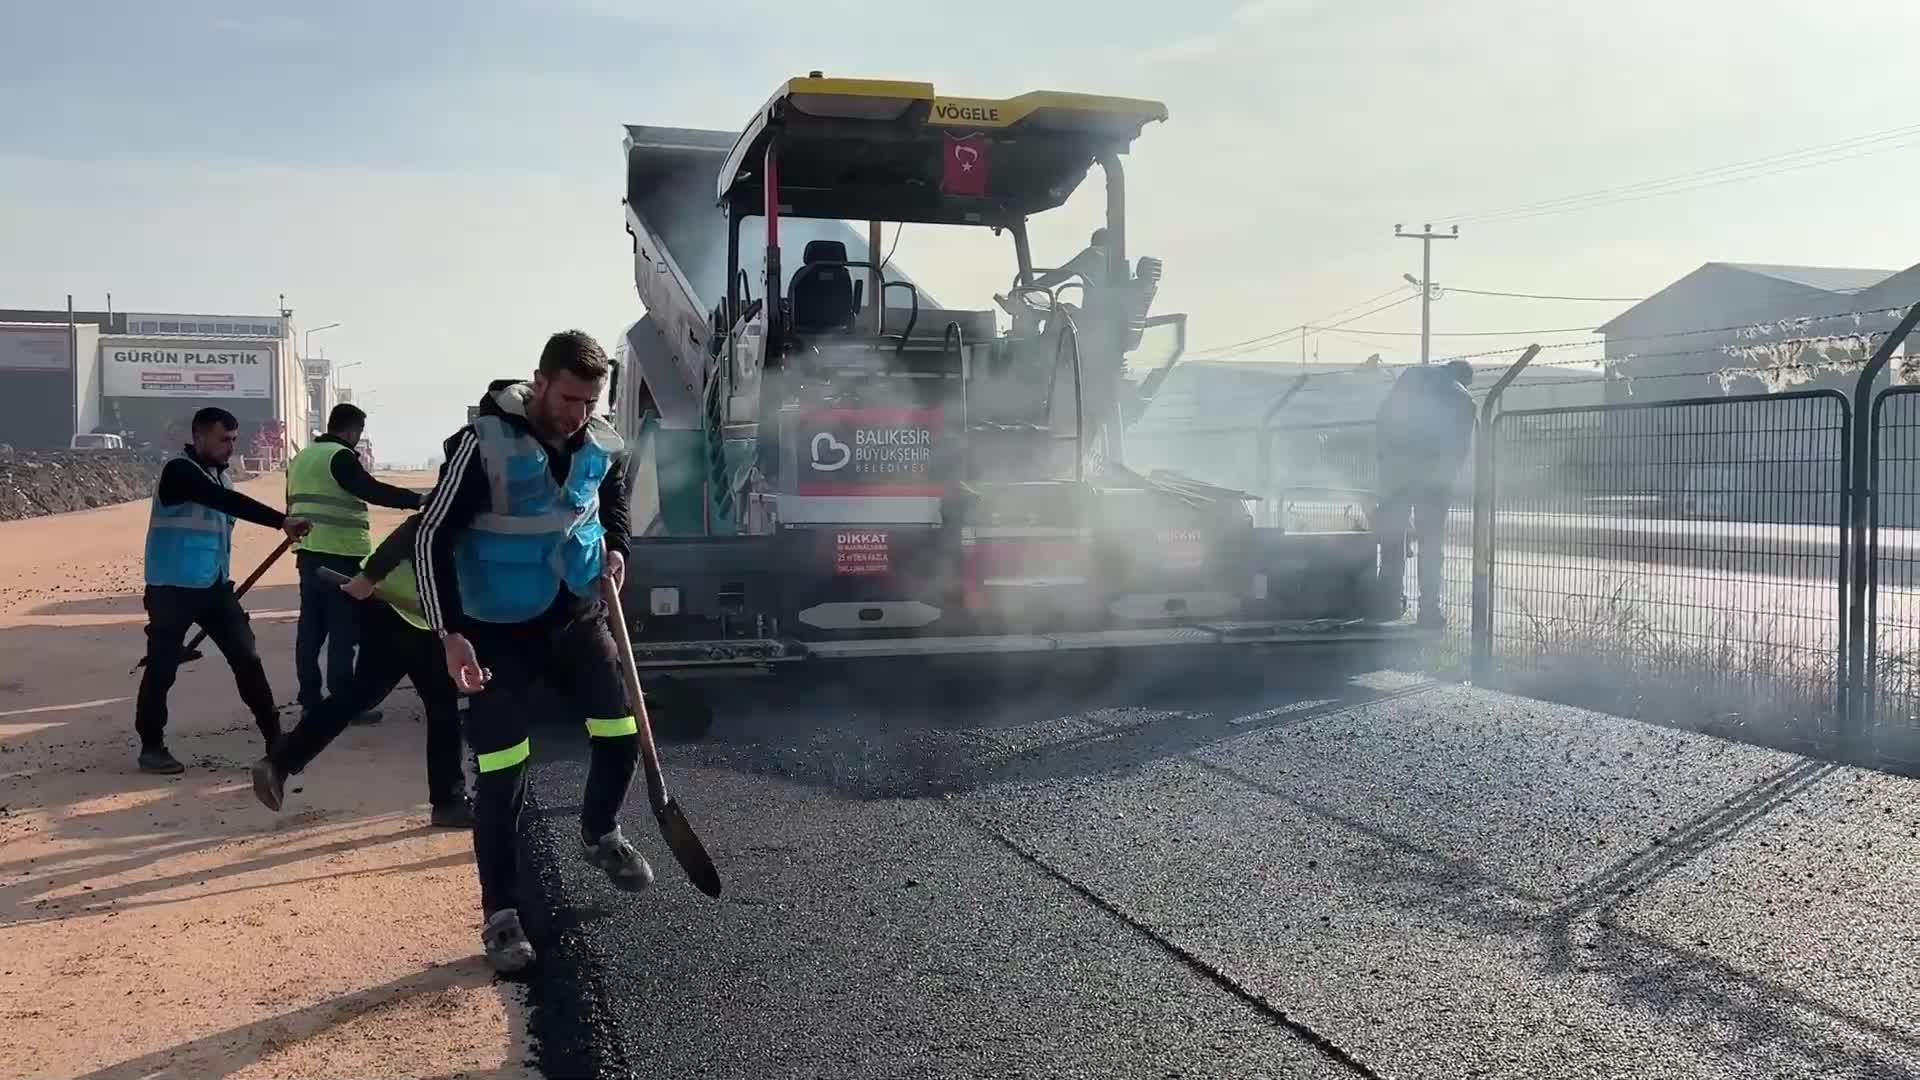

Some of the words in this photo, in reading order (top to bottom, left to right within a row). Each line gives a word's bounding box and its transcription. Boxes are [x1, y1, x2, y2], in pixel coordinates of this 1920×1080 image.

[935, 103, 999, 121] VÖGELE
[114, 350, 178, 364] GÜRÜN
[184, 352, 259, 365] PLASTİK
[855, 427, 930, 445] BALIKESİR
[855, 446, 930, 462] BÜYÜKŞEHİR
[855, 463, 928, 472] BELEDİYES
[837, 533, 889, 544] DİKKAT
